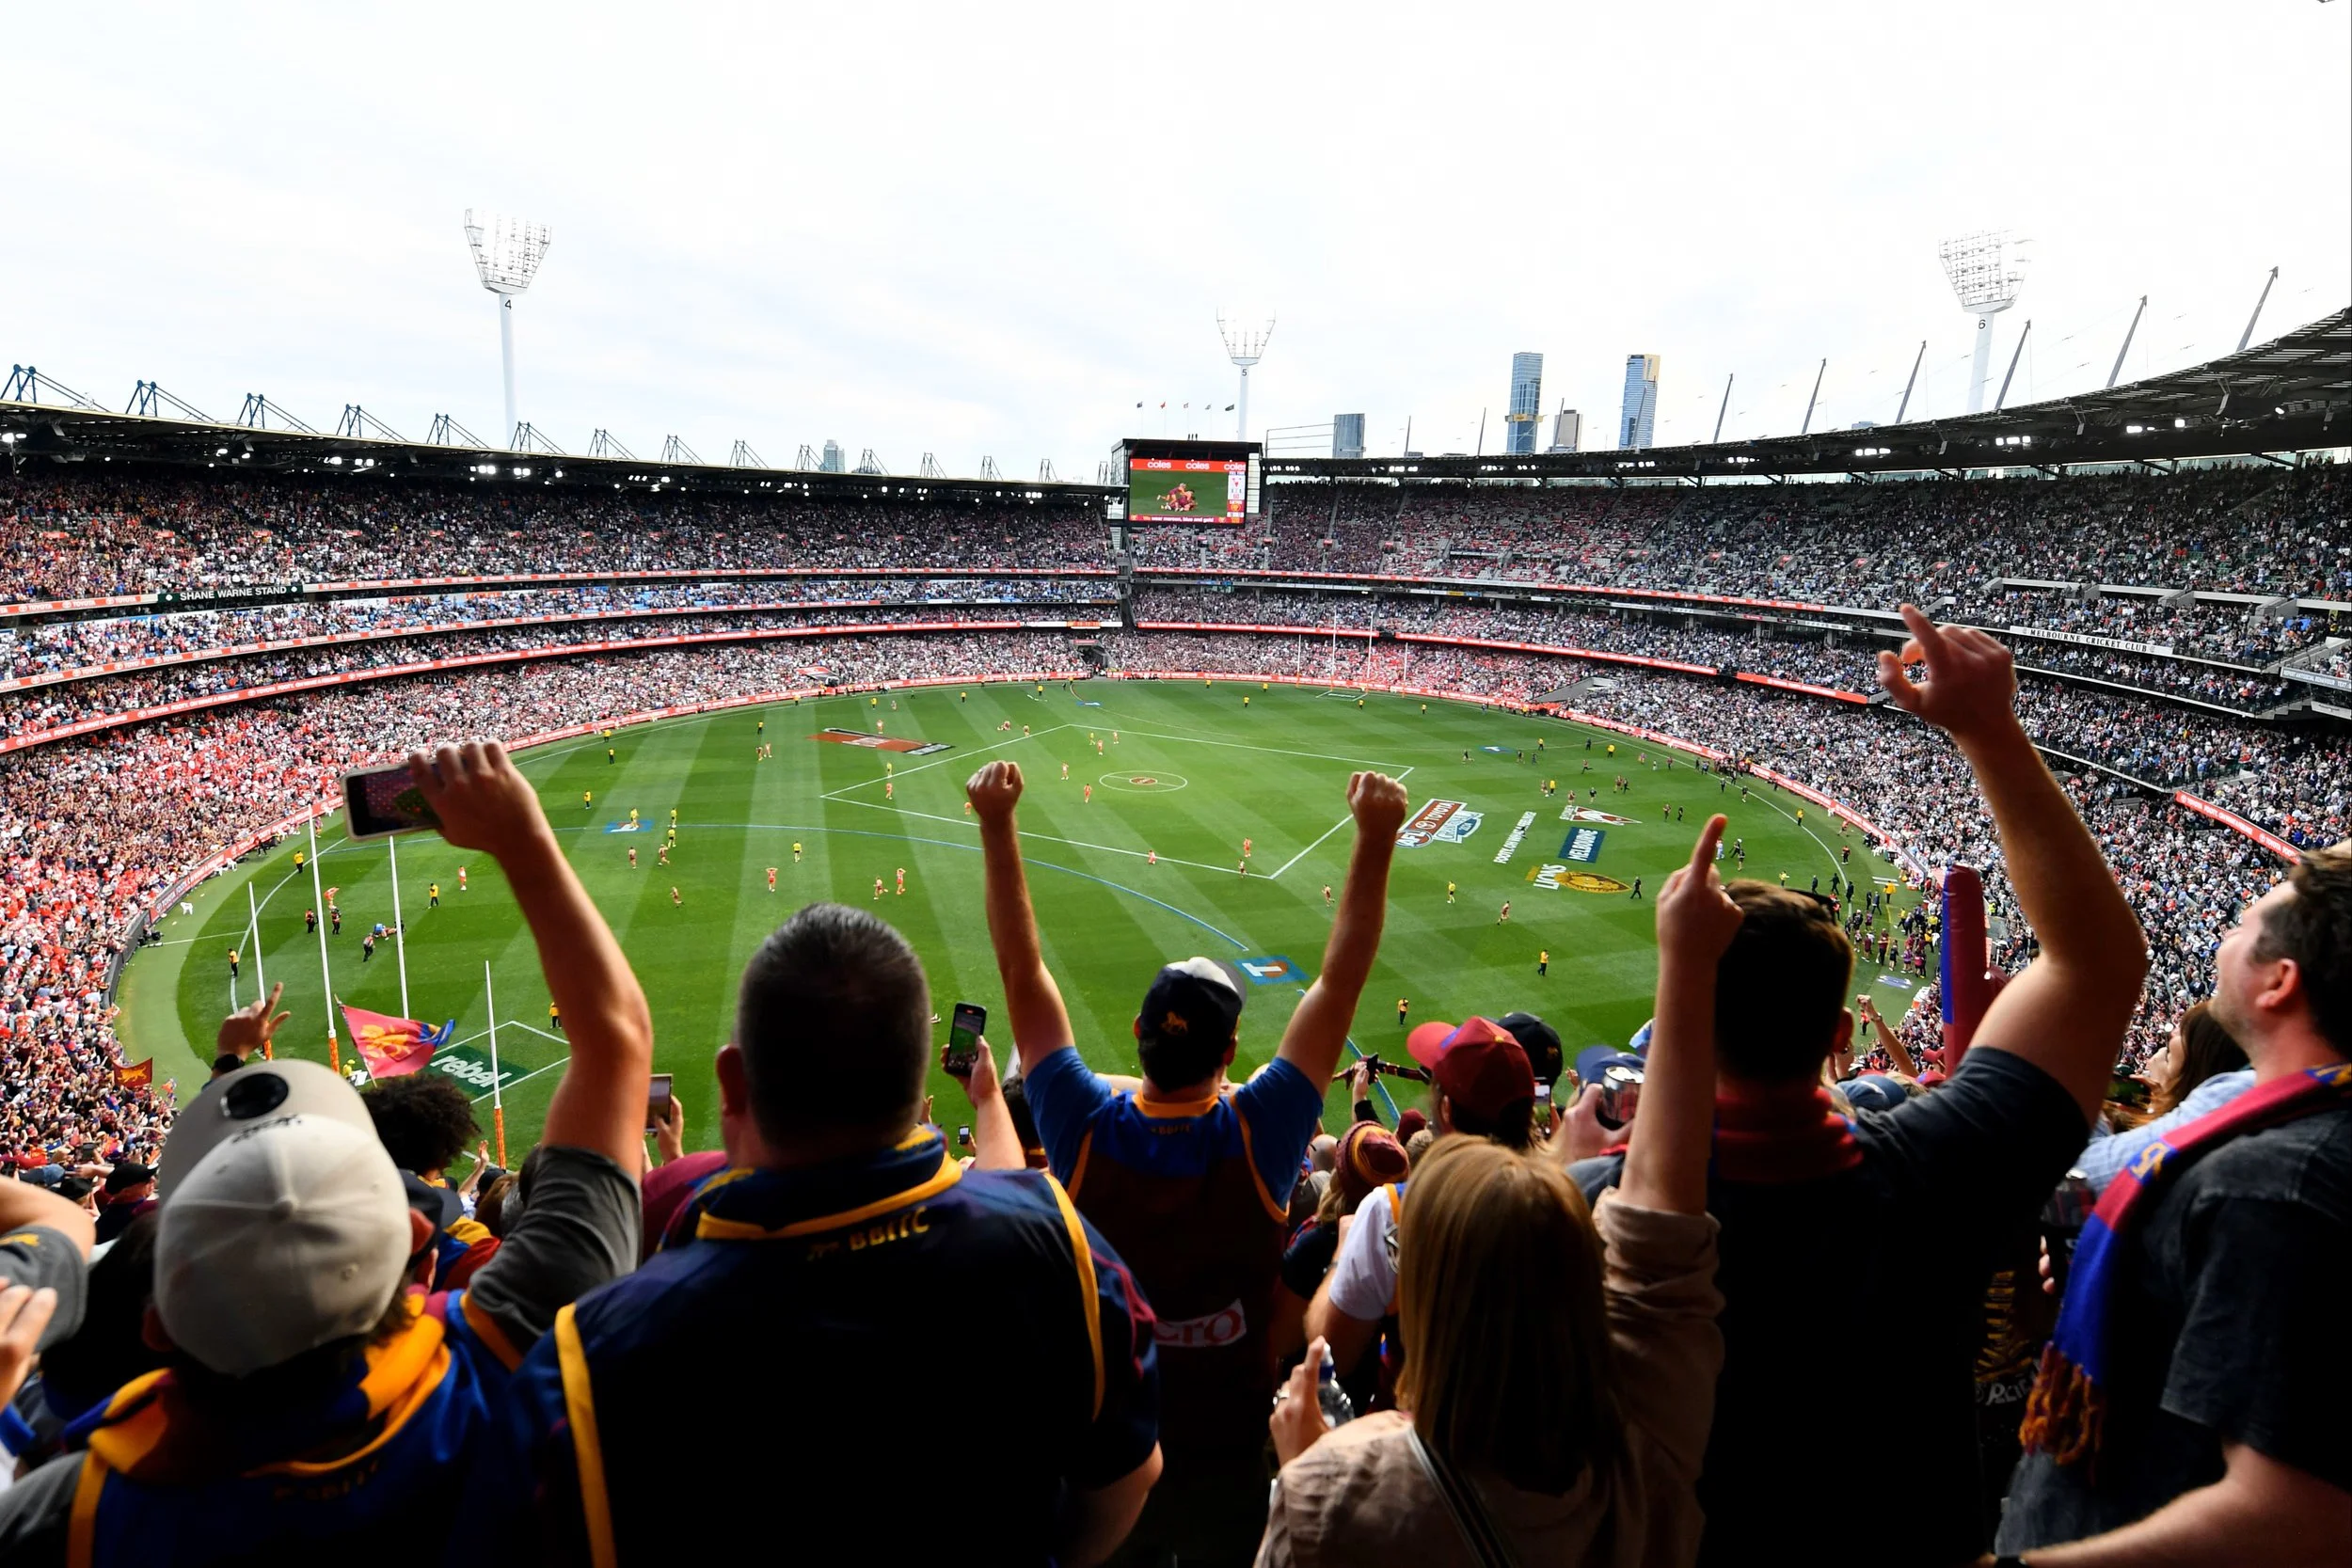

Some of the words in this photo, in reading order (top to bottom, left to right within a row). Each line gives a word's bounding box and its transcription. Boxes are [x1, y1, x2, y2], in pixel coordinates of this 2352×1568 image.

[504, 299, 512, 310] 4
[1979, 319, 1986, 329] 6
[1242, 368, 1248, 376] 5
[115, 595, 136, 604] TOYOTA
[180, 590, 215, 601] SHANE
[217, 587, 253, 598] WARNE
[255, 585, 287, 595] STAND
[28, 603, 53, 611] TOYOTA
[72, 599, 96, 608] TOYOTA
[2030, 629, 2081, 642] MELBOURNE
[2086, 637, 2122, 648] CRICKET
[2125, 642, 2148, 652] CLUB
[125, 659, 146, 668] TOYOA
[0, 679, 21, 688] OYOTA
[1423, 801, 1455, 821] TOYOTA
[1396, 831, 1426, 847] AFL
[1567, 828, 1598, 862] MELBOURNE
[1534, 863, 1567, 890] LIONS
[430, 1054, 513, 1088] rebel
[1154, 1308, 1241, 1345] ero
